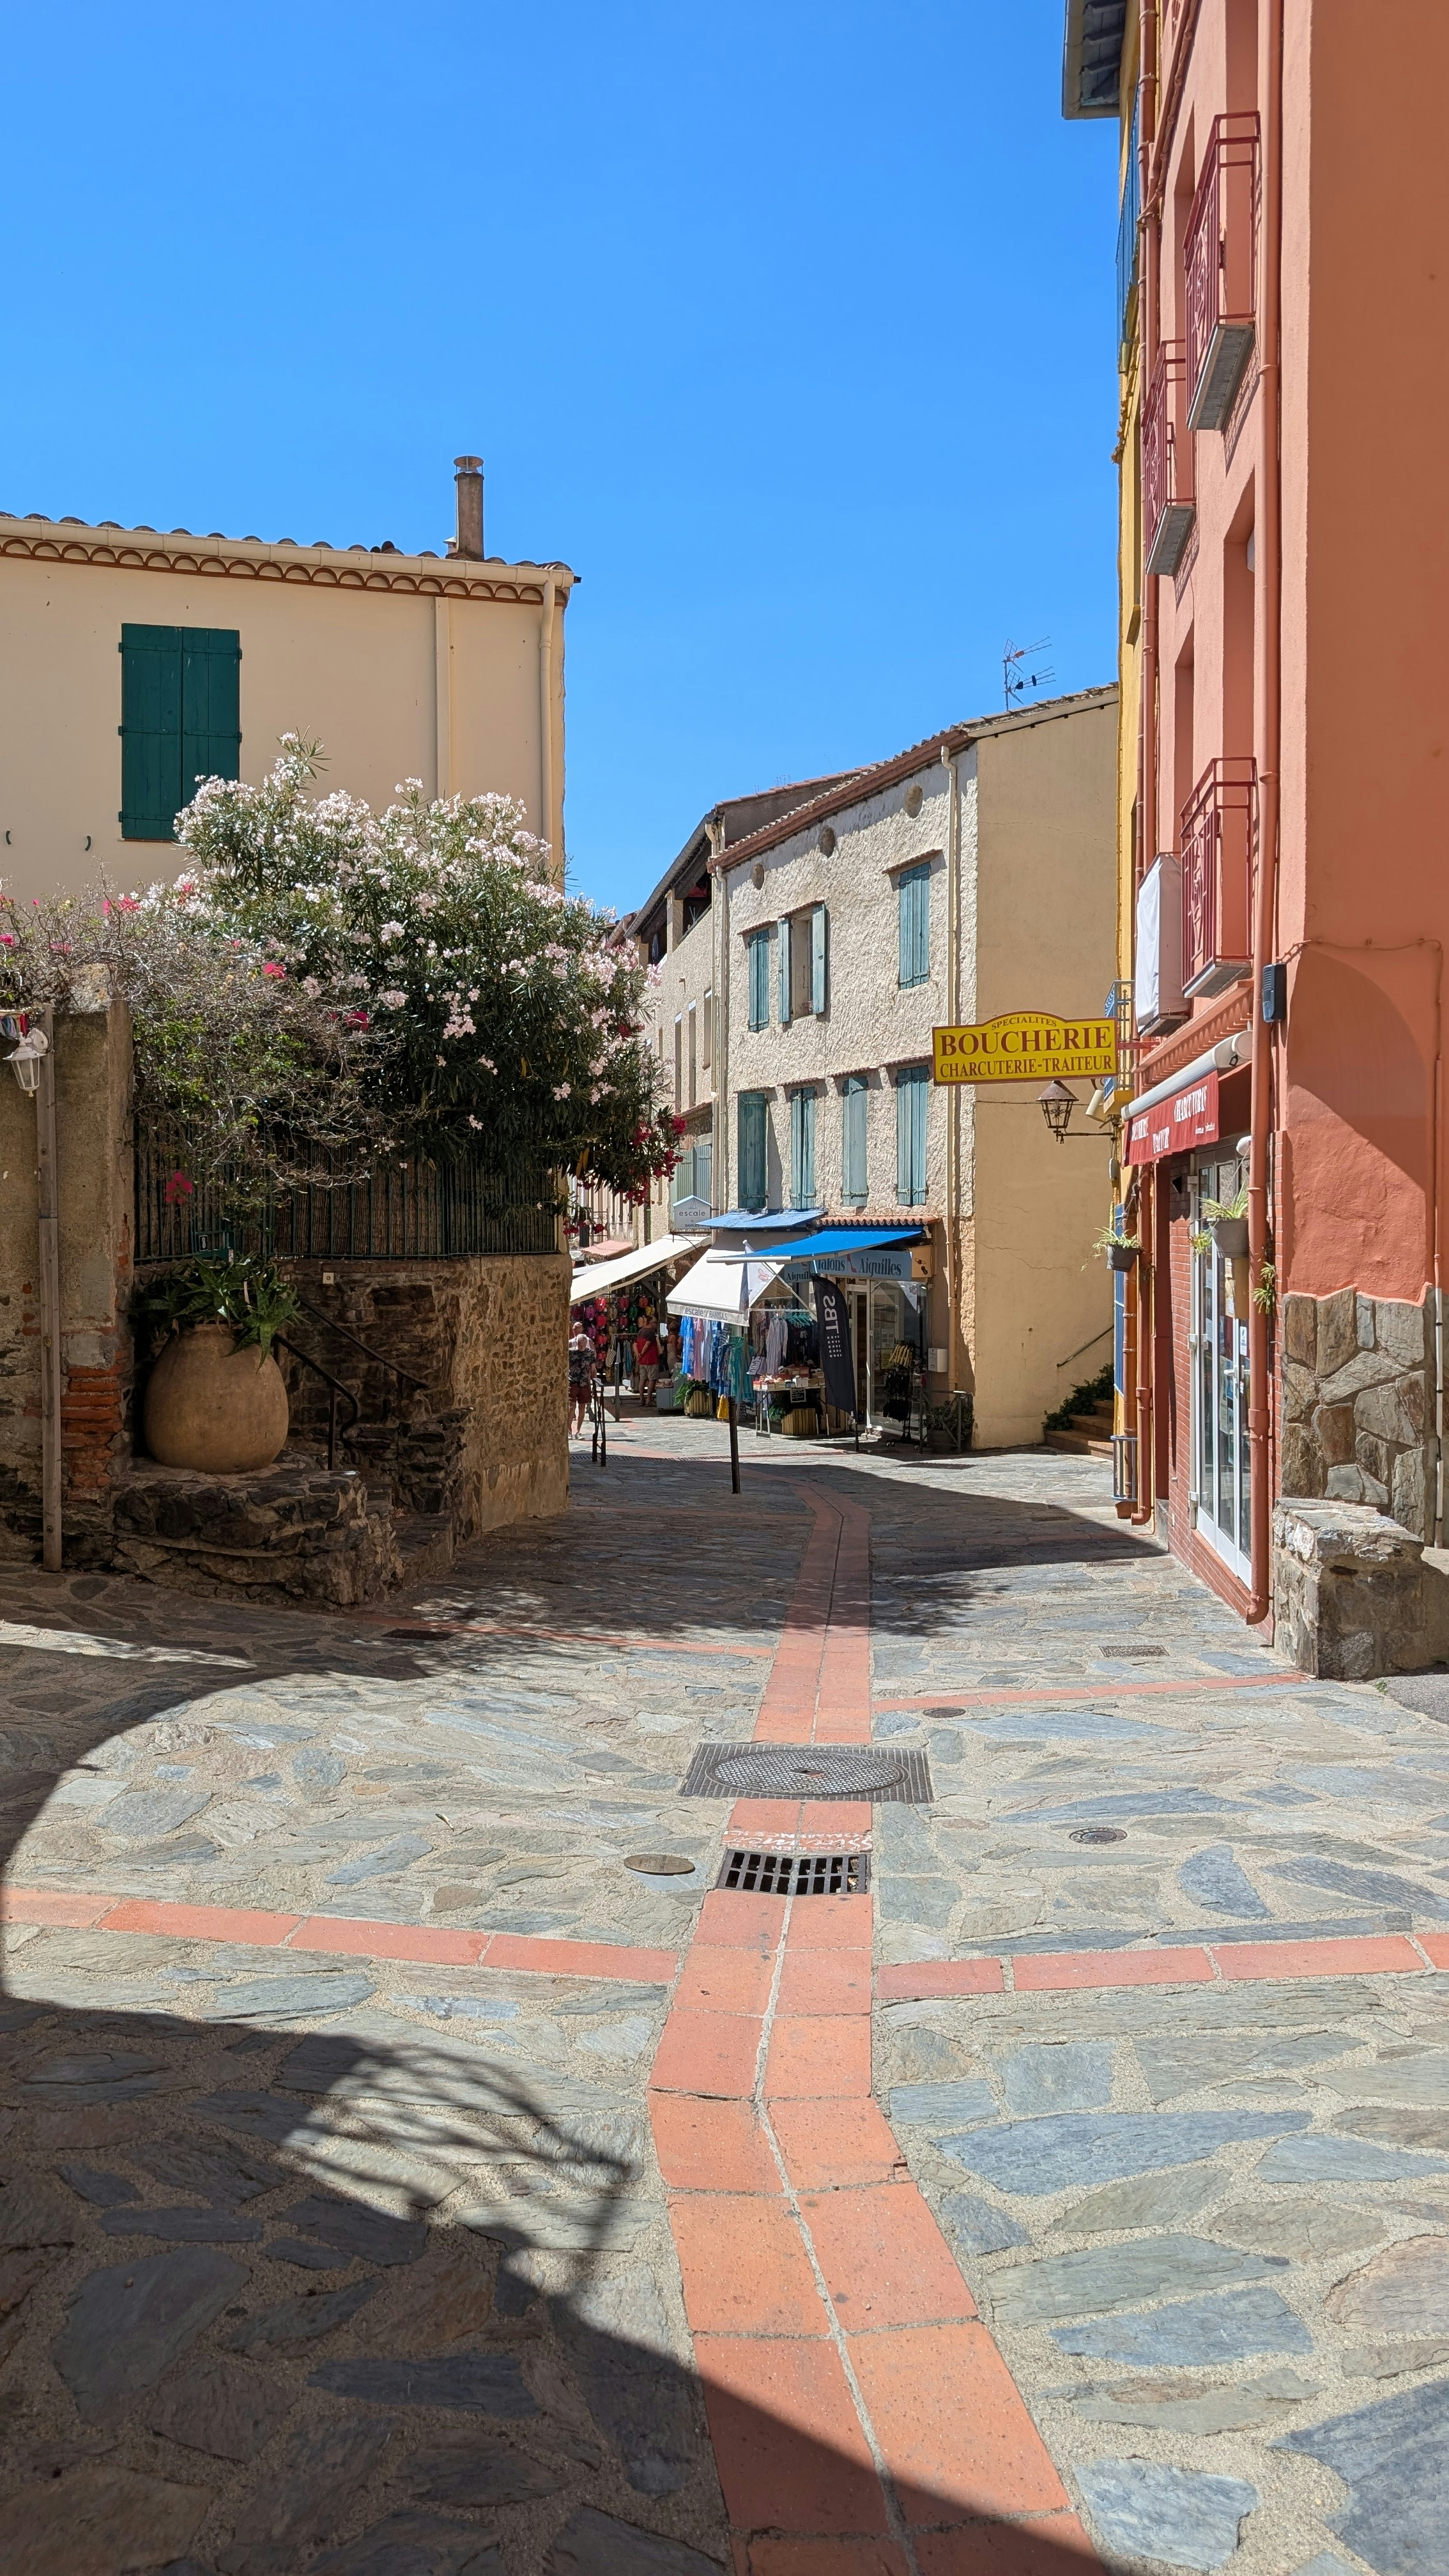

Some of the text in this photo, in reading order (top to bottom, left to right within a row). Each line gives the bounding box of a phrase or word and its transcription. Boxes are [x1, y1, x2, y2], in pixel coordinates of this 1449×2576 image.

[940, 1026, 1112, 1056] BOUCHERIE
[940, 1055, 1112, 1078] CHARCUTERIE-TRAITEUR
[202, 1237, 206, 1249] 8
[859, 1257, 902, 1277] Aiguilles
[685, 1308, 703, 1317] escale
